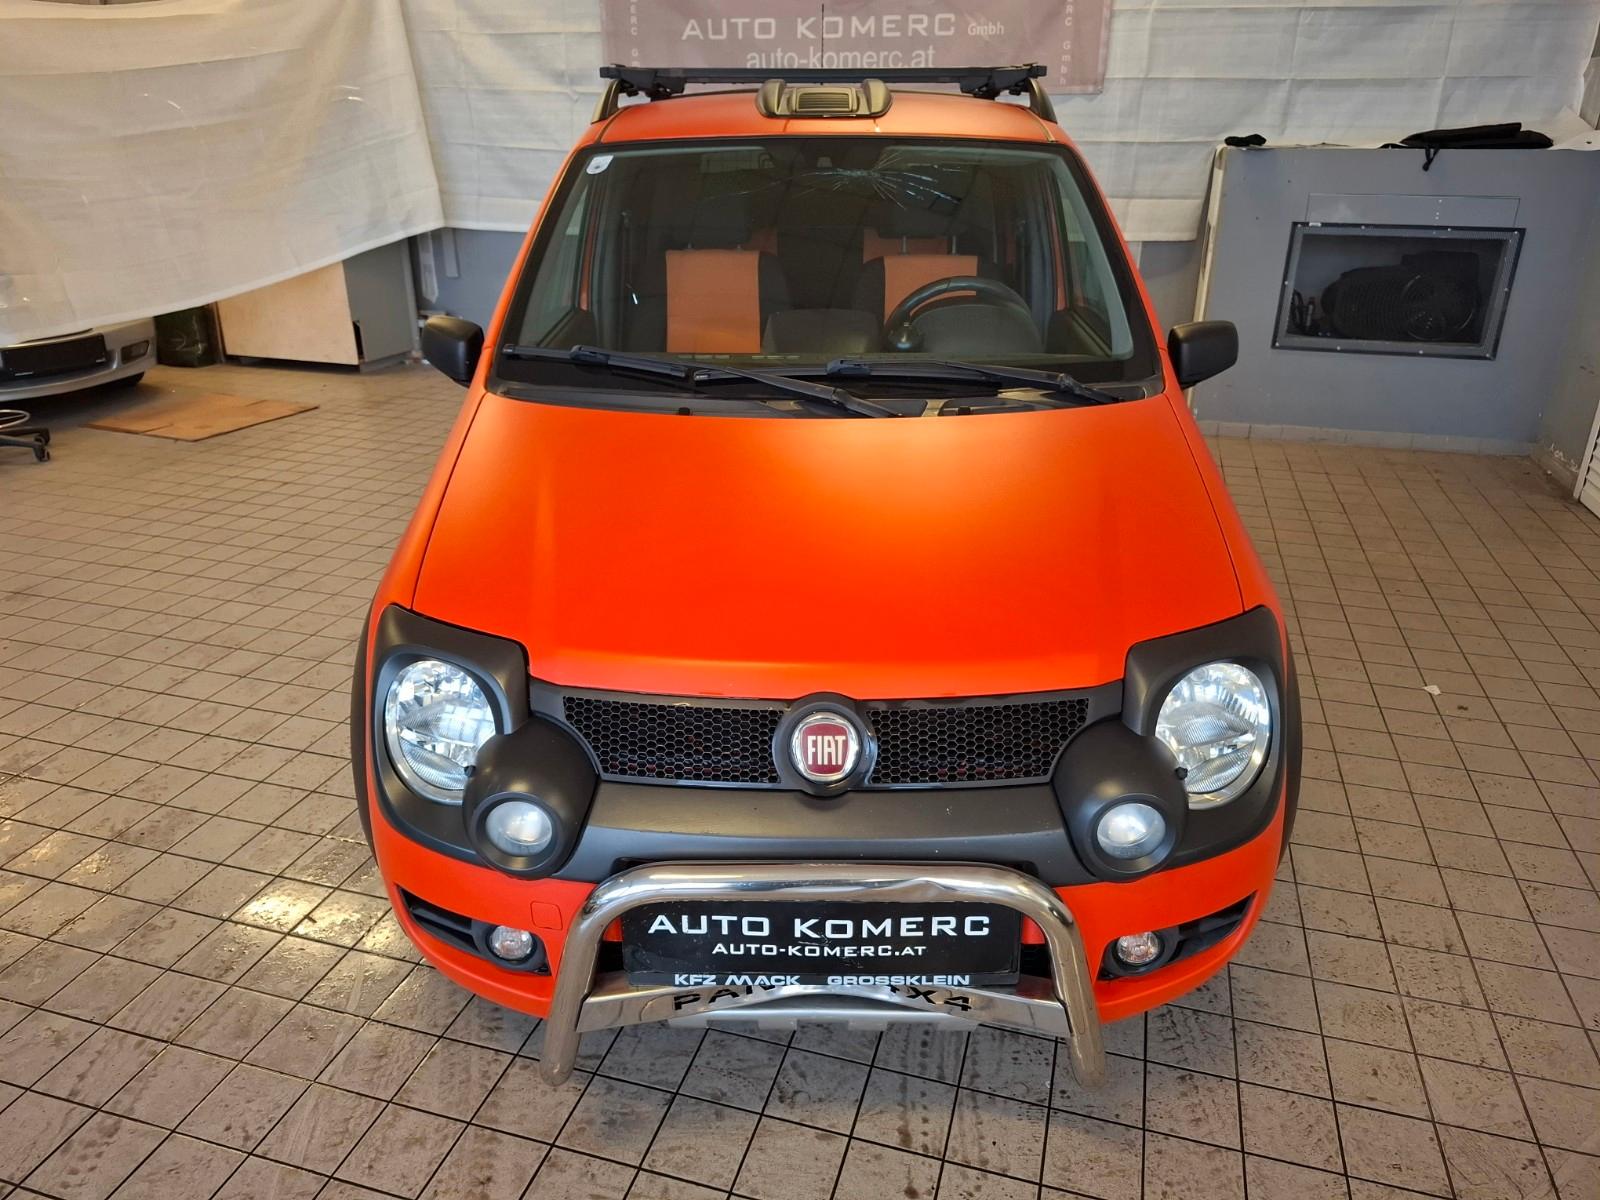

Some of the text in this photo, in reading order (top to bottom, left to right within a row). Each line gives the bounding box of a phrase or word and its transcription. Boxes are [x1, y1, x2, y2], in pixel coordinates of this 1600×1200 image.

[681, 13, 1004, 40] AUTO KOMERC Gmbh
[746, 45, 935, 68] auto-komerc.at
[807, 735, 846, 765] FIAT
[648, 914, 990, 939] AUTO KOMERC
[711, 943, 927, 957] AUTO-KOMERC.AT
[674, 973, 970, 986] KFZ MACK GROSSKLEIN
